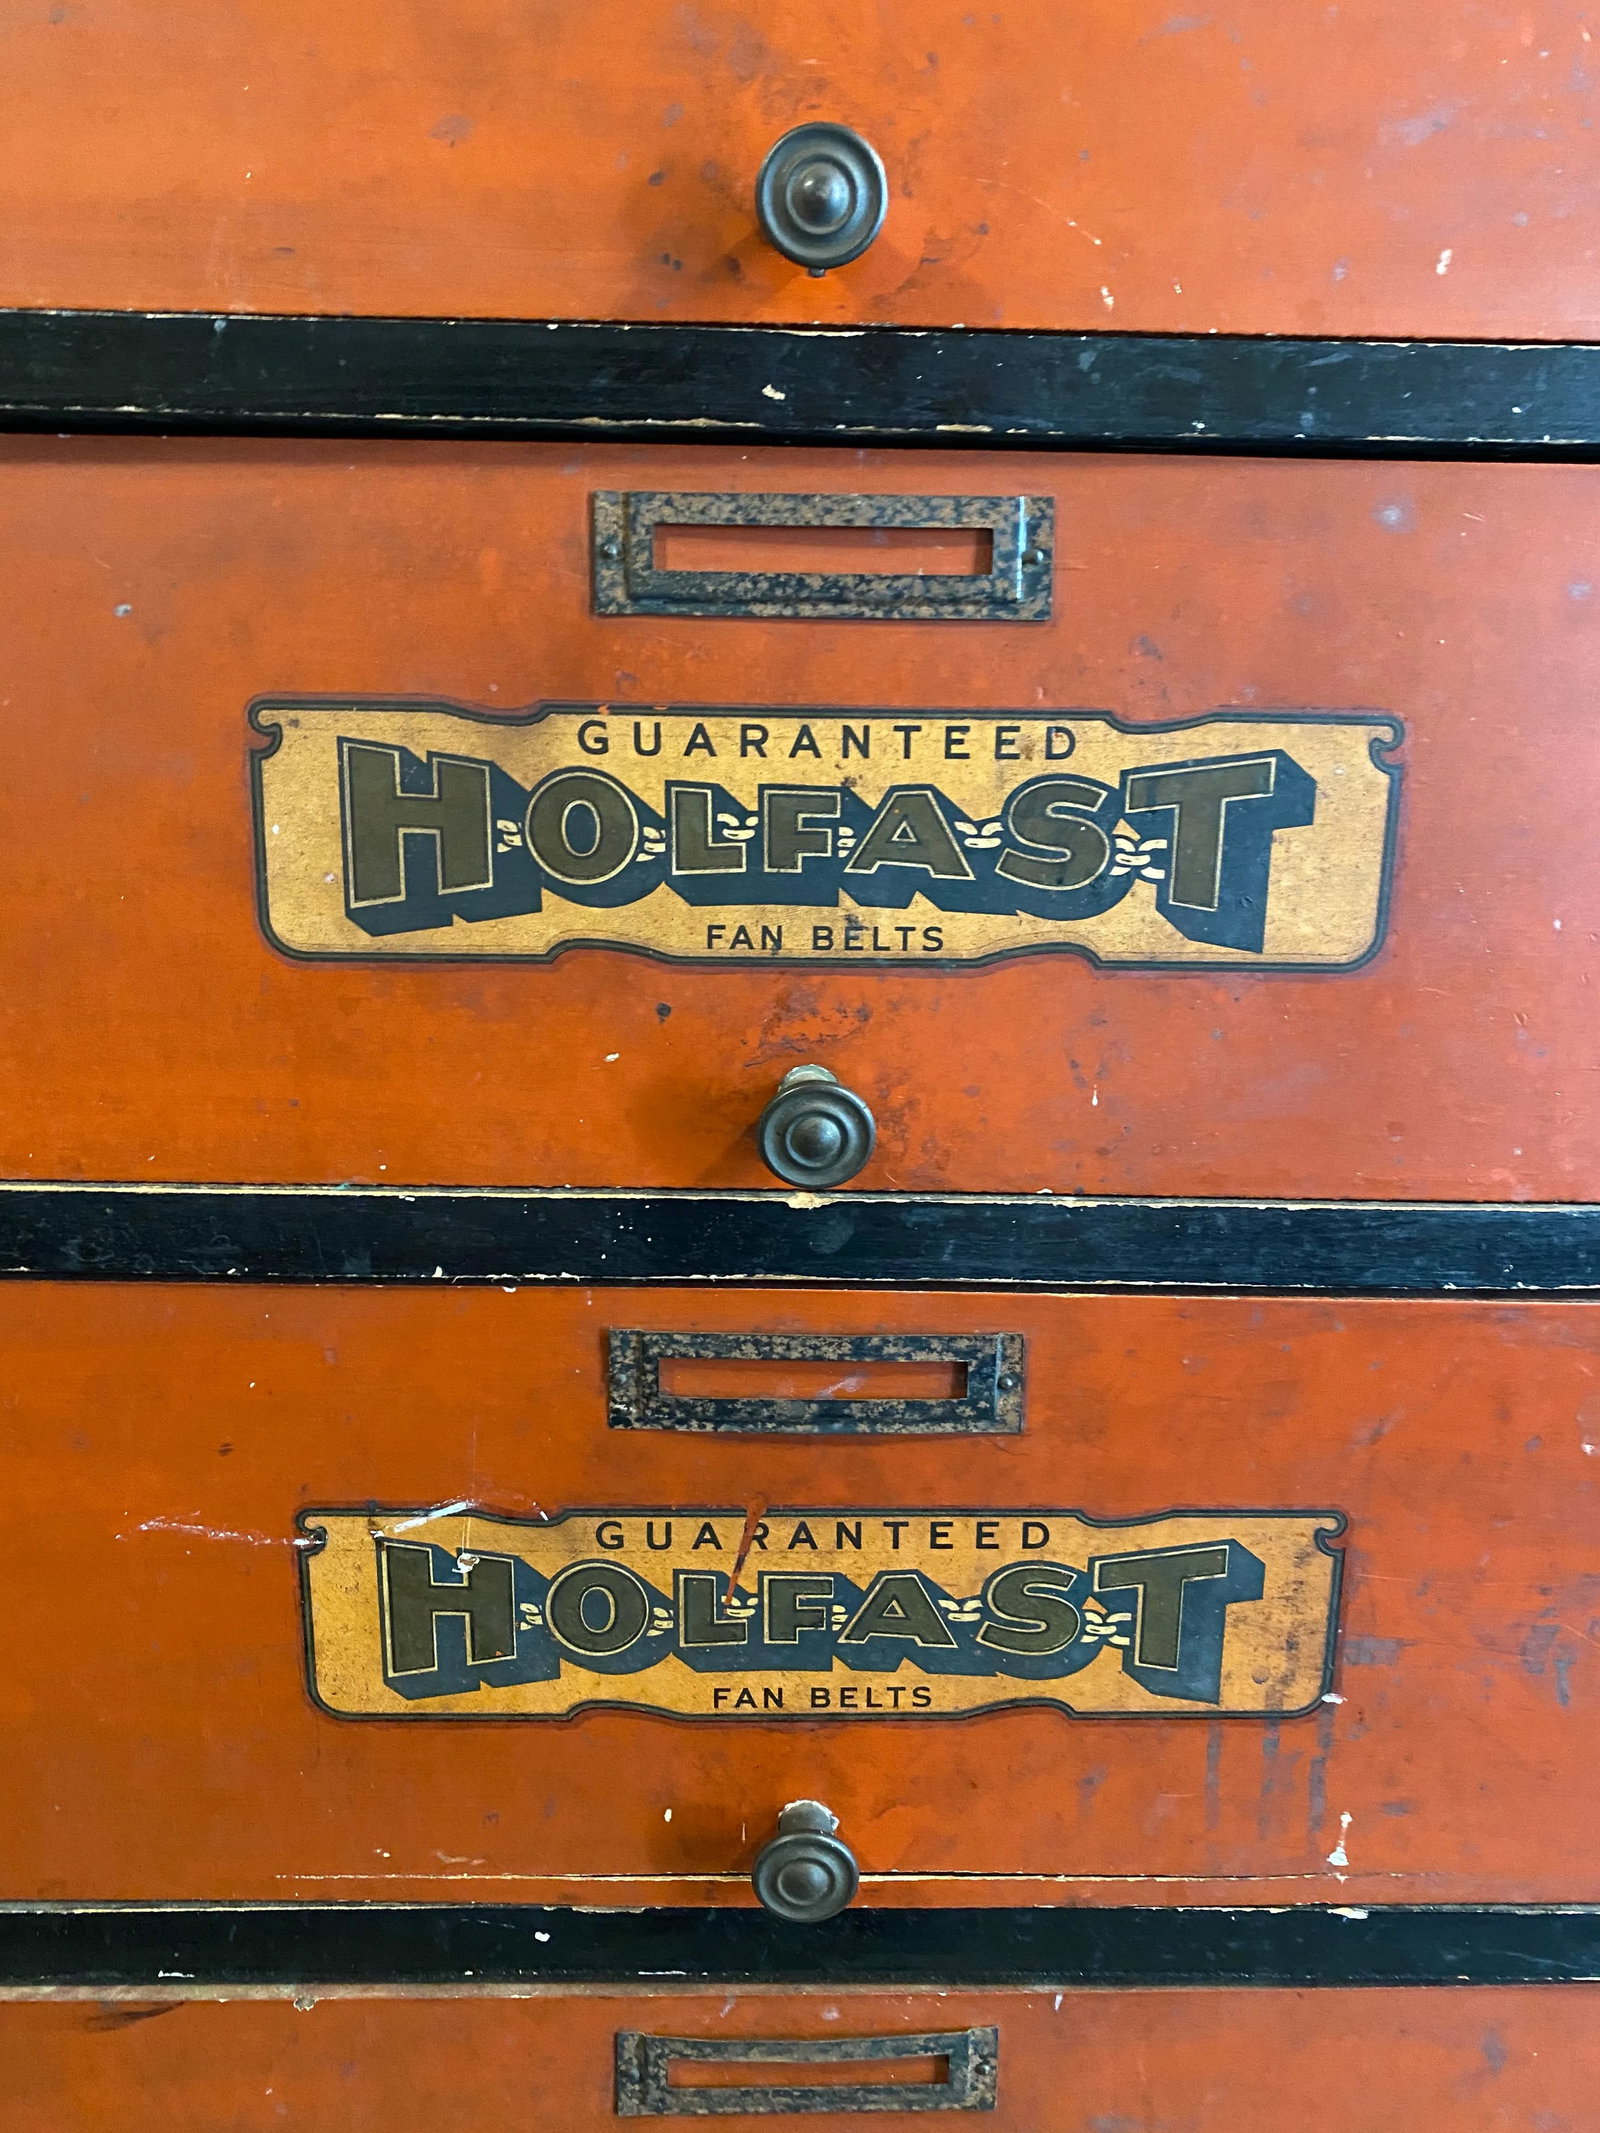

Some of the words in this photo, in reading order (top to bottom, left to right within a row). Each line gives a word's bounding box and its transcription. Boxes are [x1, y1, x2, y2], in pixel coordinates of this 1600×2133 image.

[578, 719, 1077, 761] GUARANTEED
[338, 738, 1300, 935] HOLFAST
[706, 923, 784, 952] FAN
[811, 925, 945, 952] BELTS
[595, 1520, 1051, 1551] GUARANTEED
[380, 1538, 1248, 1692] HOLFAST
[713, 1686, 785, 1709] FAN
[810, 1686, 933, 1709] BELTS
